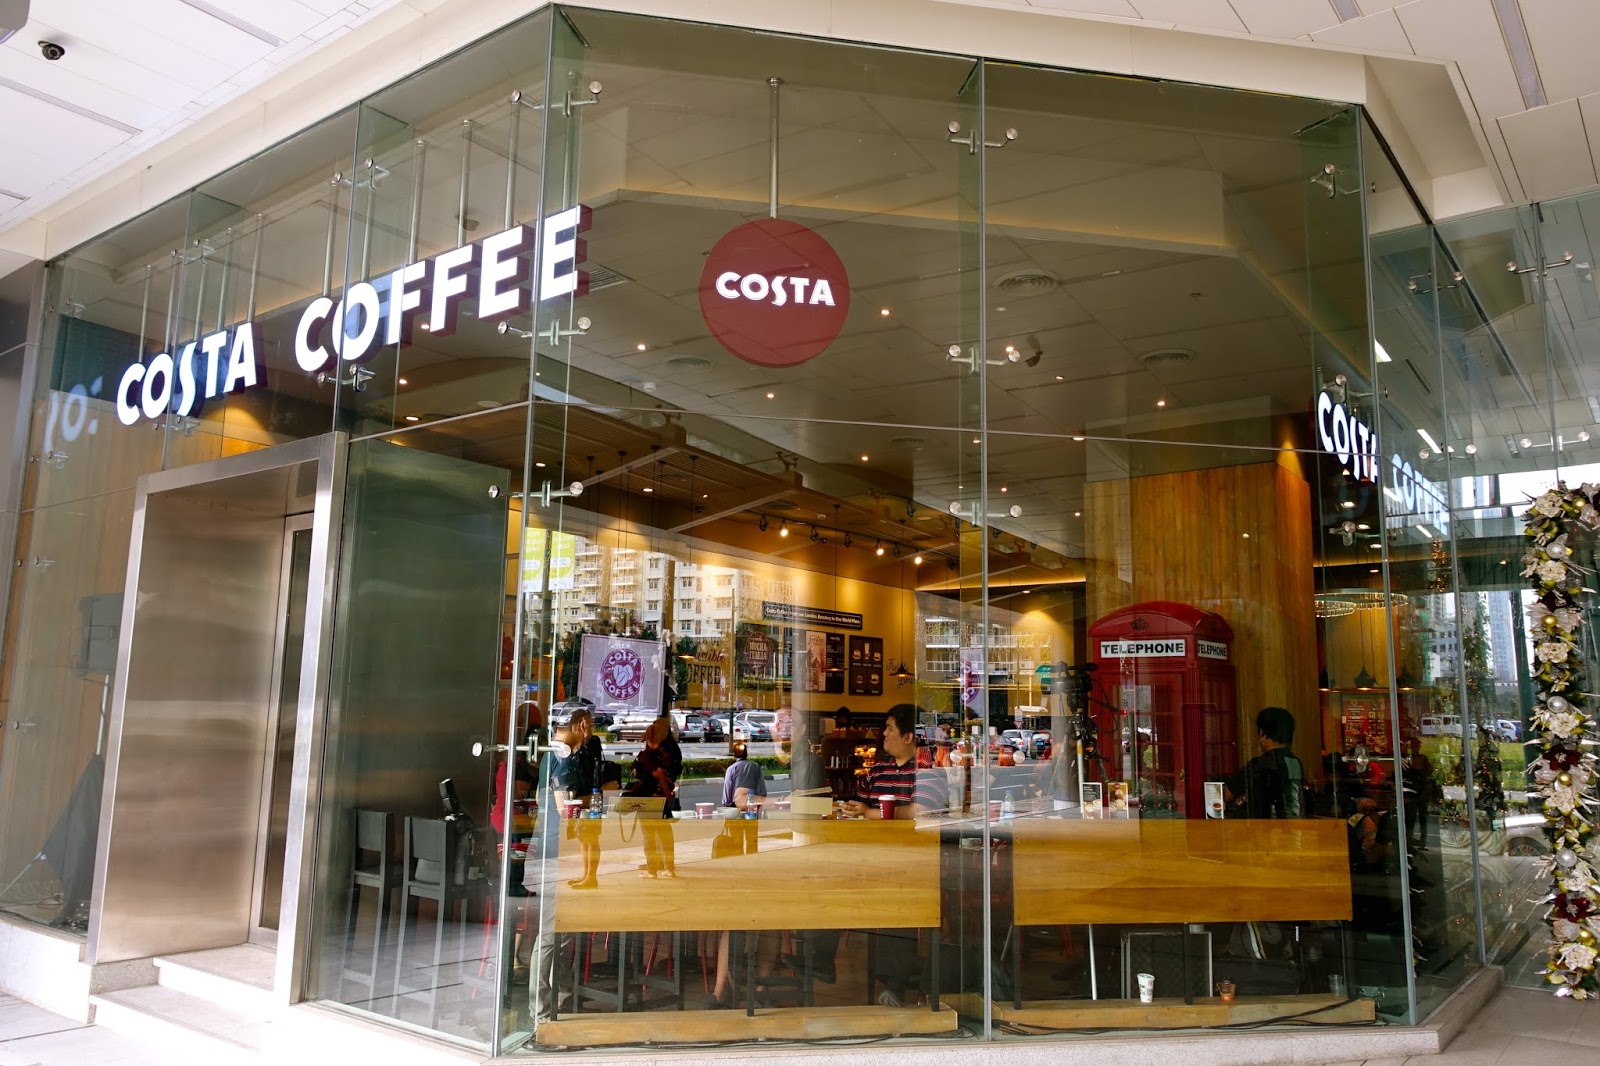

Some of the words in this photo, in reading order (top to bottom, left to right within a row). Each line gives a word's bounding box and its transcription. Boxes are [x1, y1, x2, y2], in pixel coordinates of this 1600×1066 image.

[715, 271, 836, 307] COSTA
[116, 321, 257, 426] COSTA
[294, 204, 582, 372] COFFEE
[1318, 391, 1378, 484] COSTA
[607, 651, 639, 666] COSTA
[1101, 642, 1184, 654] TELEPHONE
[1198, 643, 1227, 657] TELEPHONE
[687, 663, 720, 685] OFFEE
[604, 678, 640, 698] COFFEE
